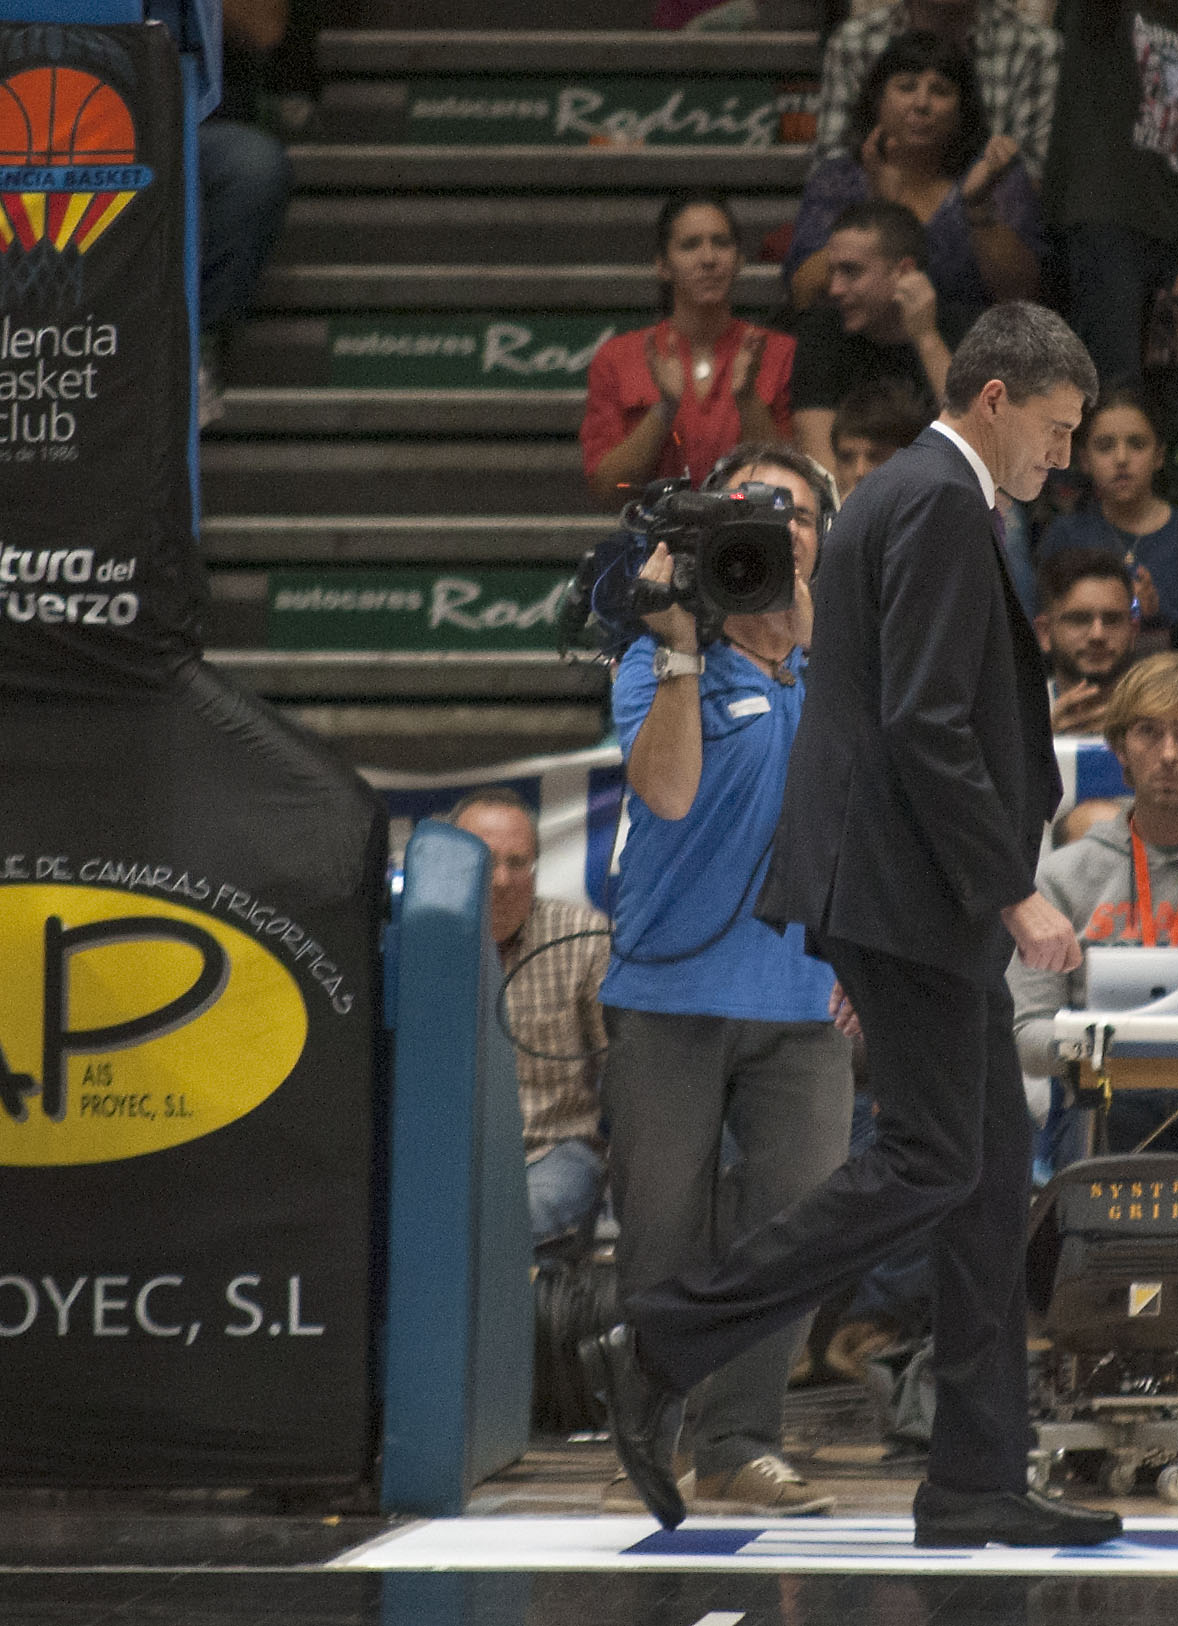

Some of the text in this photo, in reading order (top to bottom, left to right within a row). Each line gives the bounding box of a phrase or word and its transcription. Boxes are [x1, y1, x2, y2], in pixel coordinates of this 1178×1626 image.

[64, 168, 142, 186] BASKET
[0, 544, 137, 583] tura del
[36, 855, 73, 880] DE
[79, 857, 211, 901] CAMARAS
[211, 882, 354, 1016] FRIGORIFICAS
[82, 1063, 113, 1087] AIS
[80, 1092, 156, 1120] PROYEC,
[223, 1275, 325, 1337] S.L
